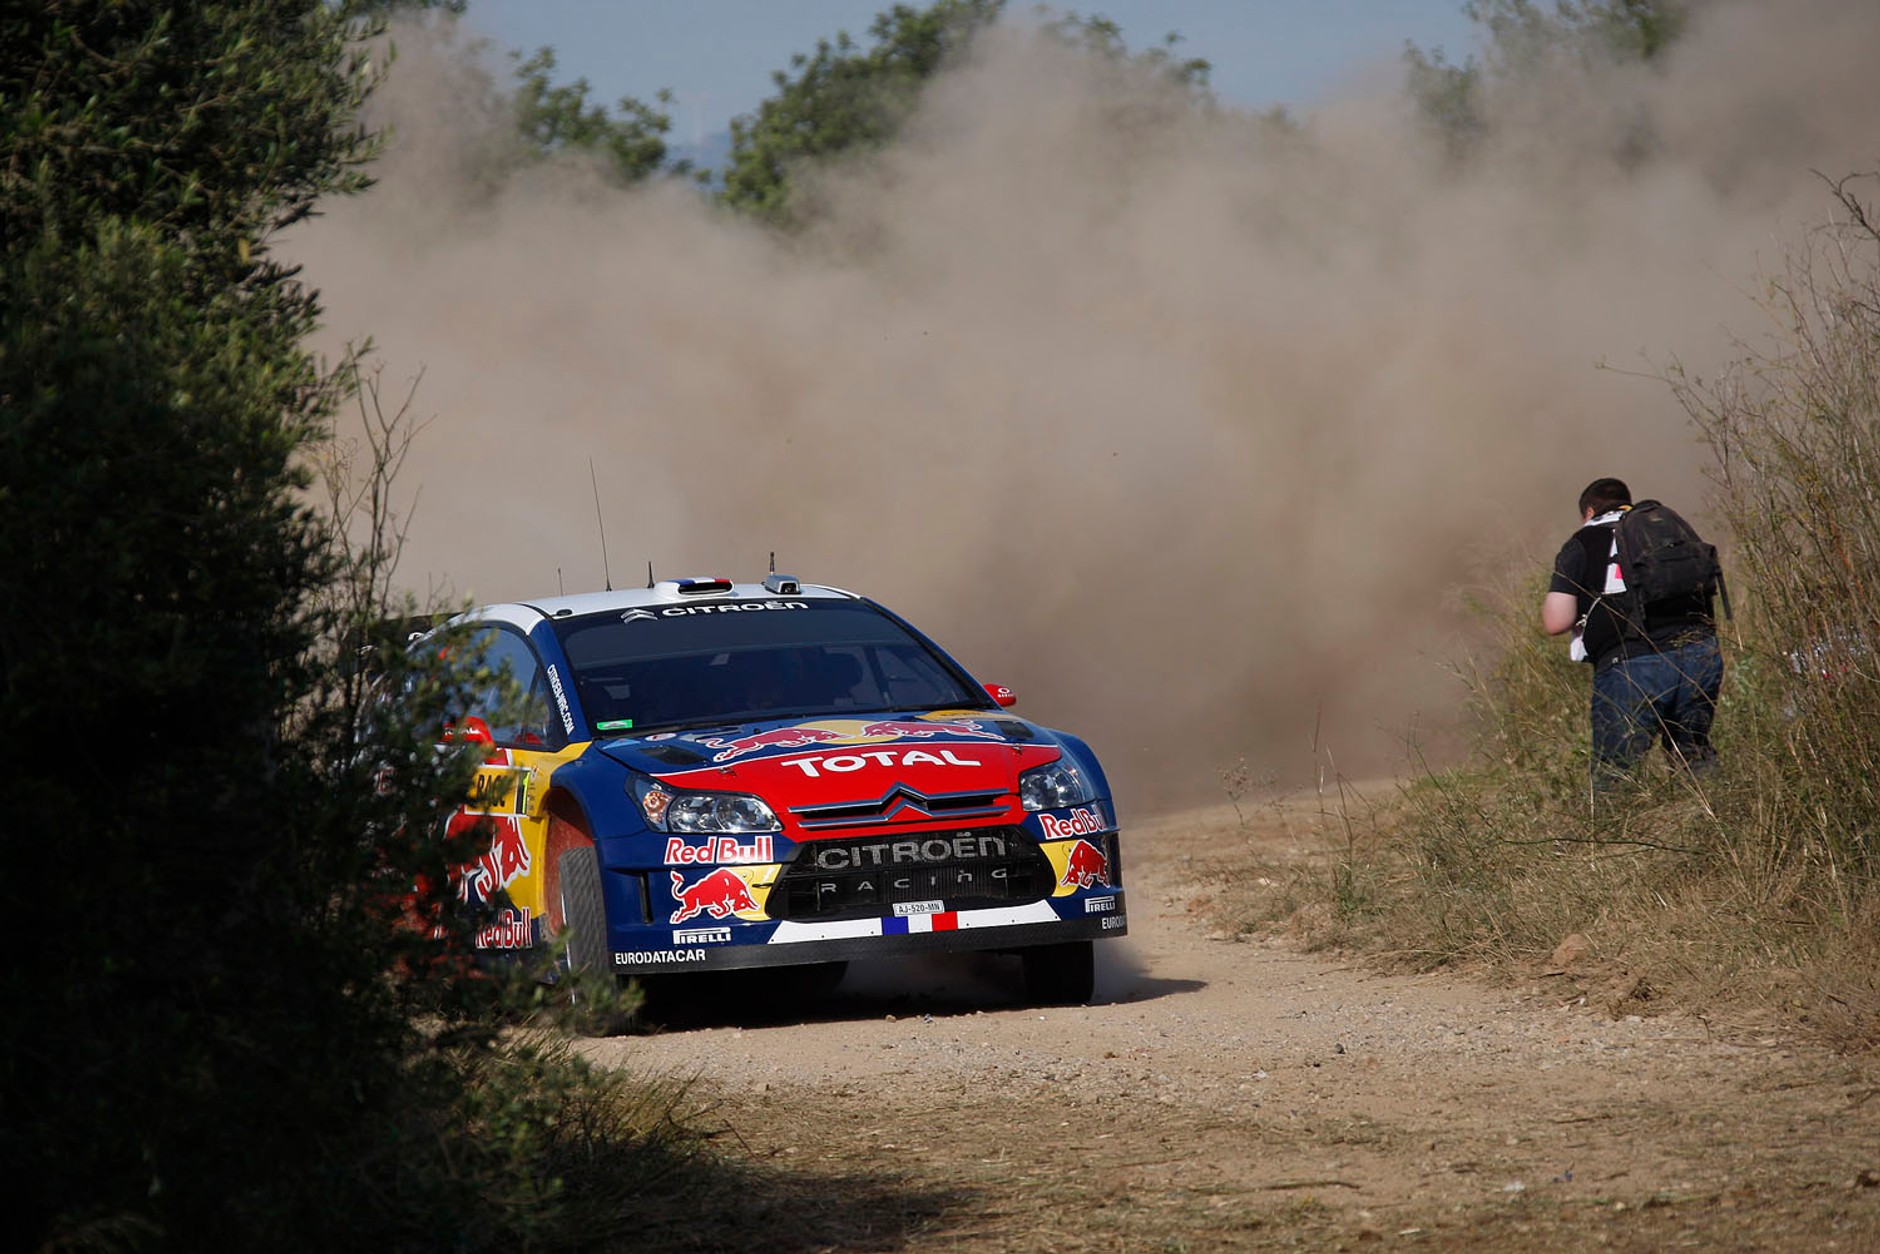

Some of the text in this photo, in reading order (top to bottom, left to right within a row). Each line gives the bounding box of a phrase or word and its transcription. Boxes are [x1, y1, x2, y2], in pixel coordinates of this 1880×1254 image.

[780, 750, 982, 777] TOTAL
[1038, 808, 1087, 839] Red
[664, 835, 775, 865] Red Bull
[1084, 895, 1116, 914] PIRELLI
[503, 906, 533, 949] Bull
[672, 927, 732, 945] PIRELLI
[615, 949, 706, 965] EURODATACAR
